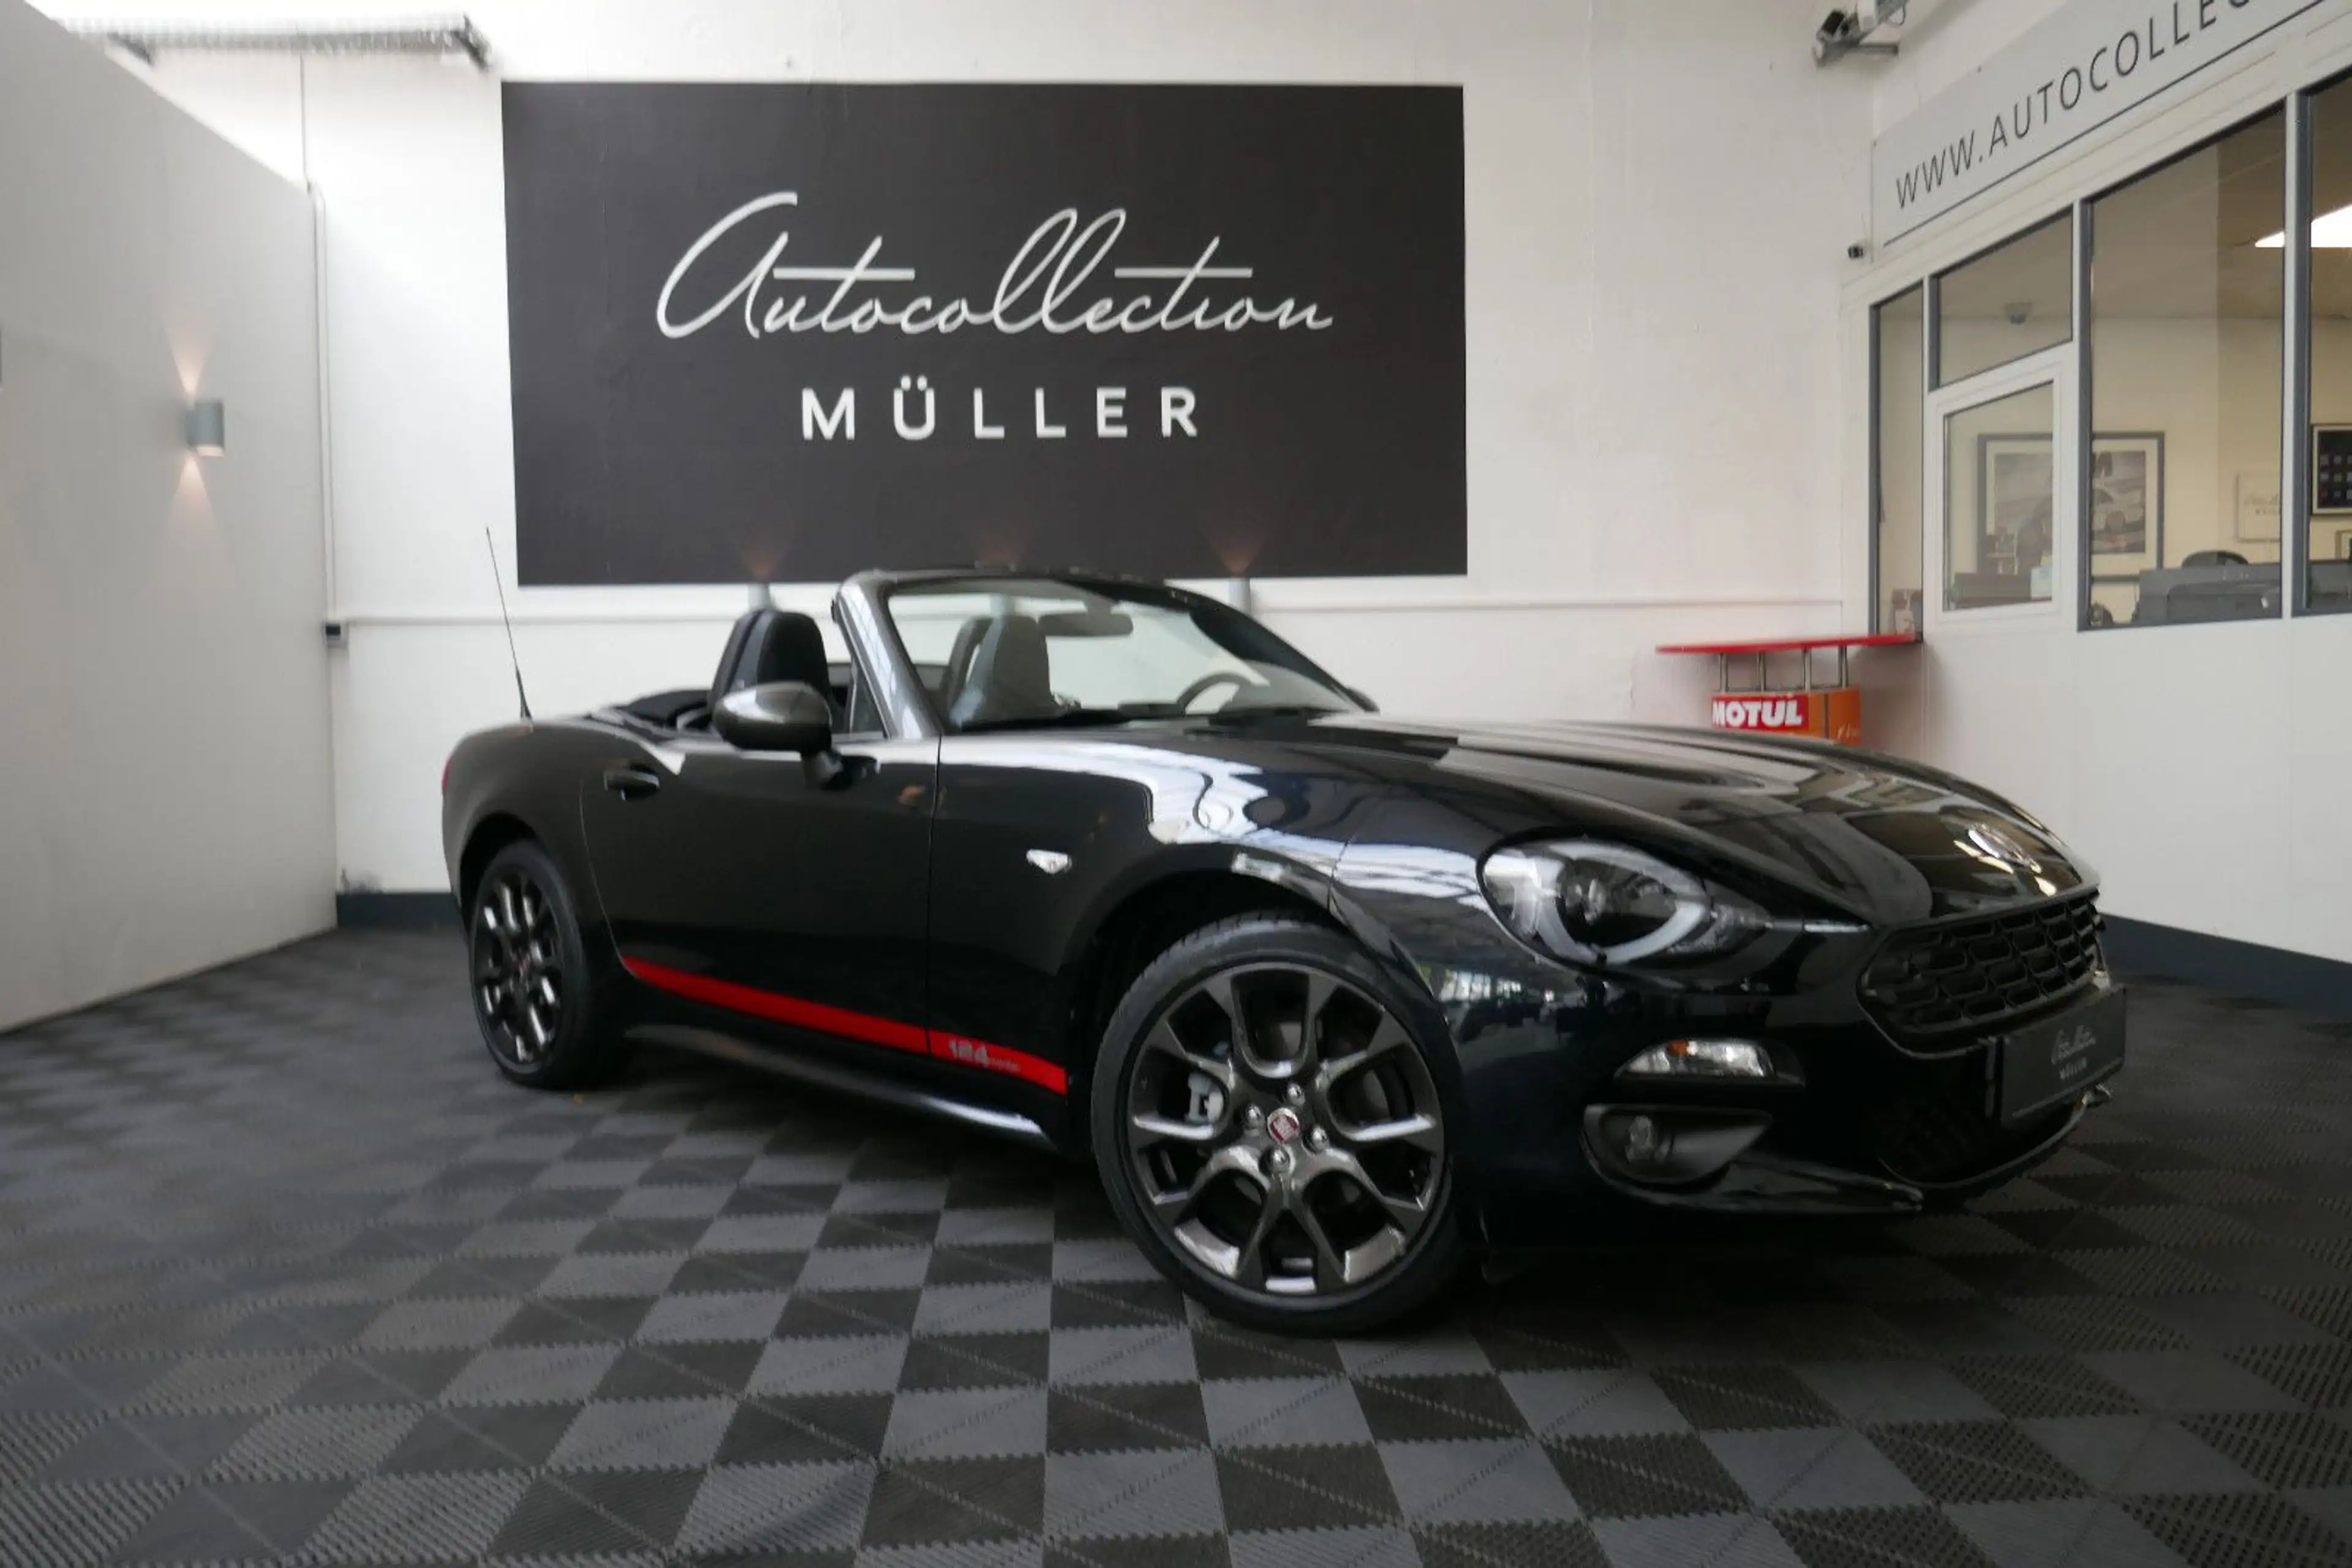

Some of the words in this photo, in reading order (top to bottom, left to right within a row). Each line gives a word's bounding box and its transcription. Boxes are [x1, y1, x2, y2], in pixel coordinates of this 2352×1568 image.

[1896, 0, 2250, 209] WWW.AUTOCOLLE
[656, 191, 1333, 339] Autocollection
[801, 375, 1197, 440] MÜLLER
[1712, 700, 1802, 728] MOTUL
